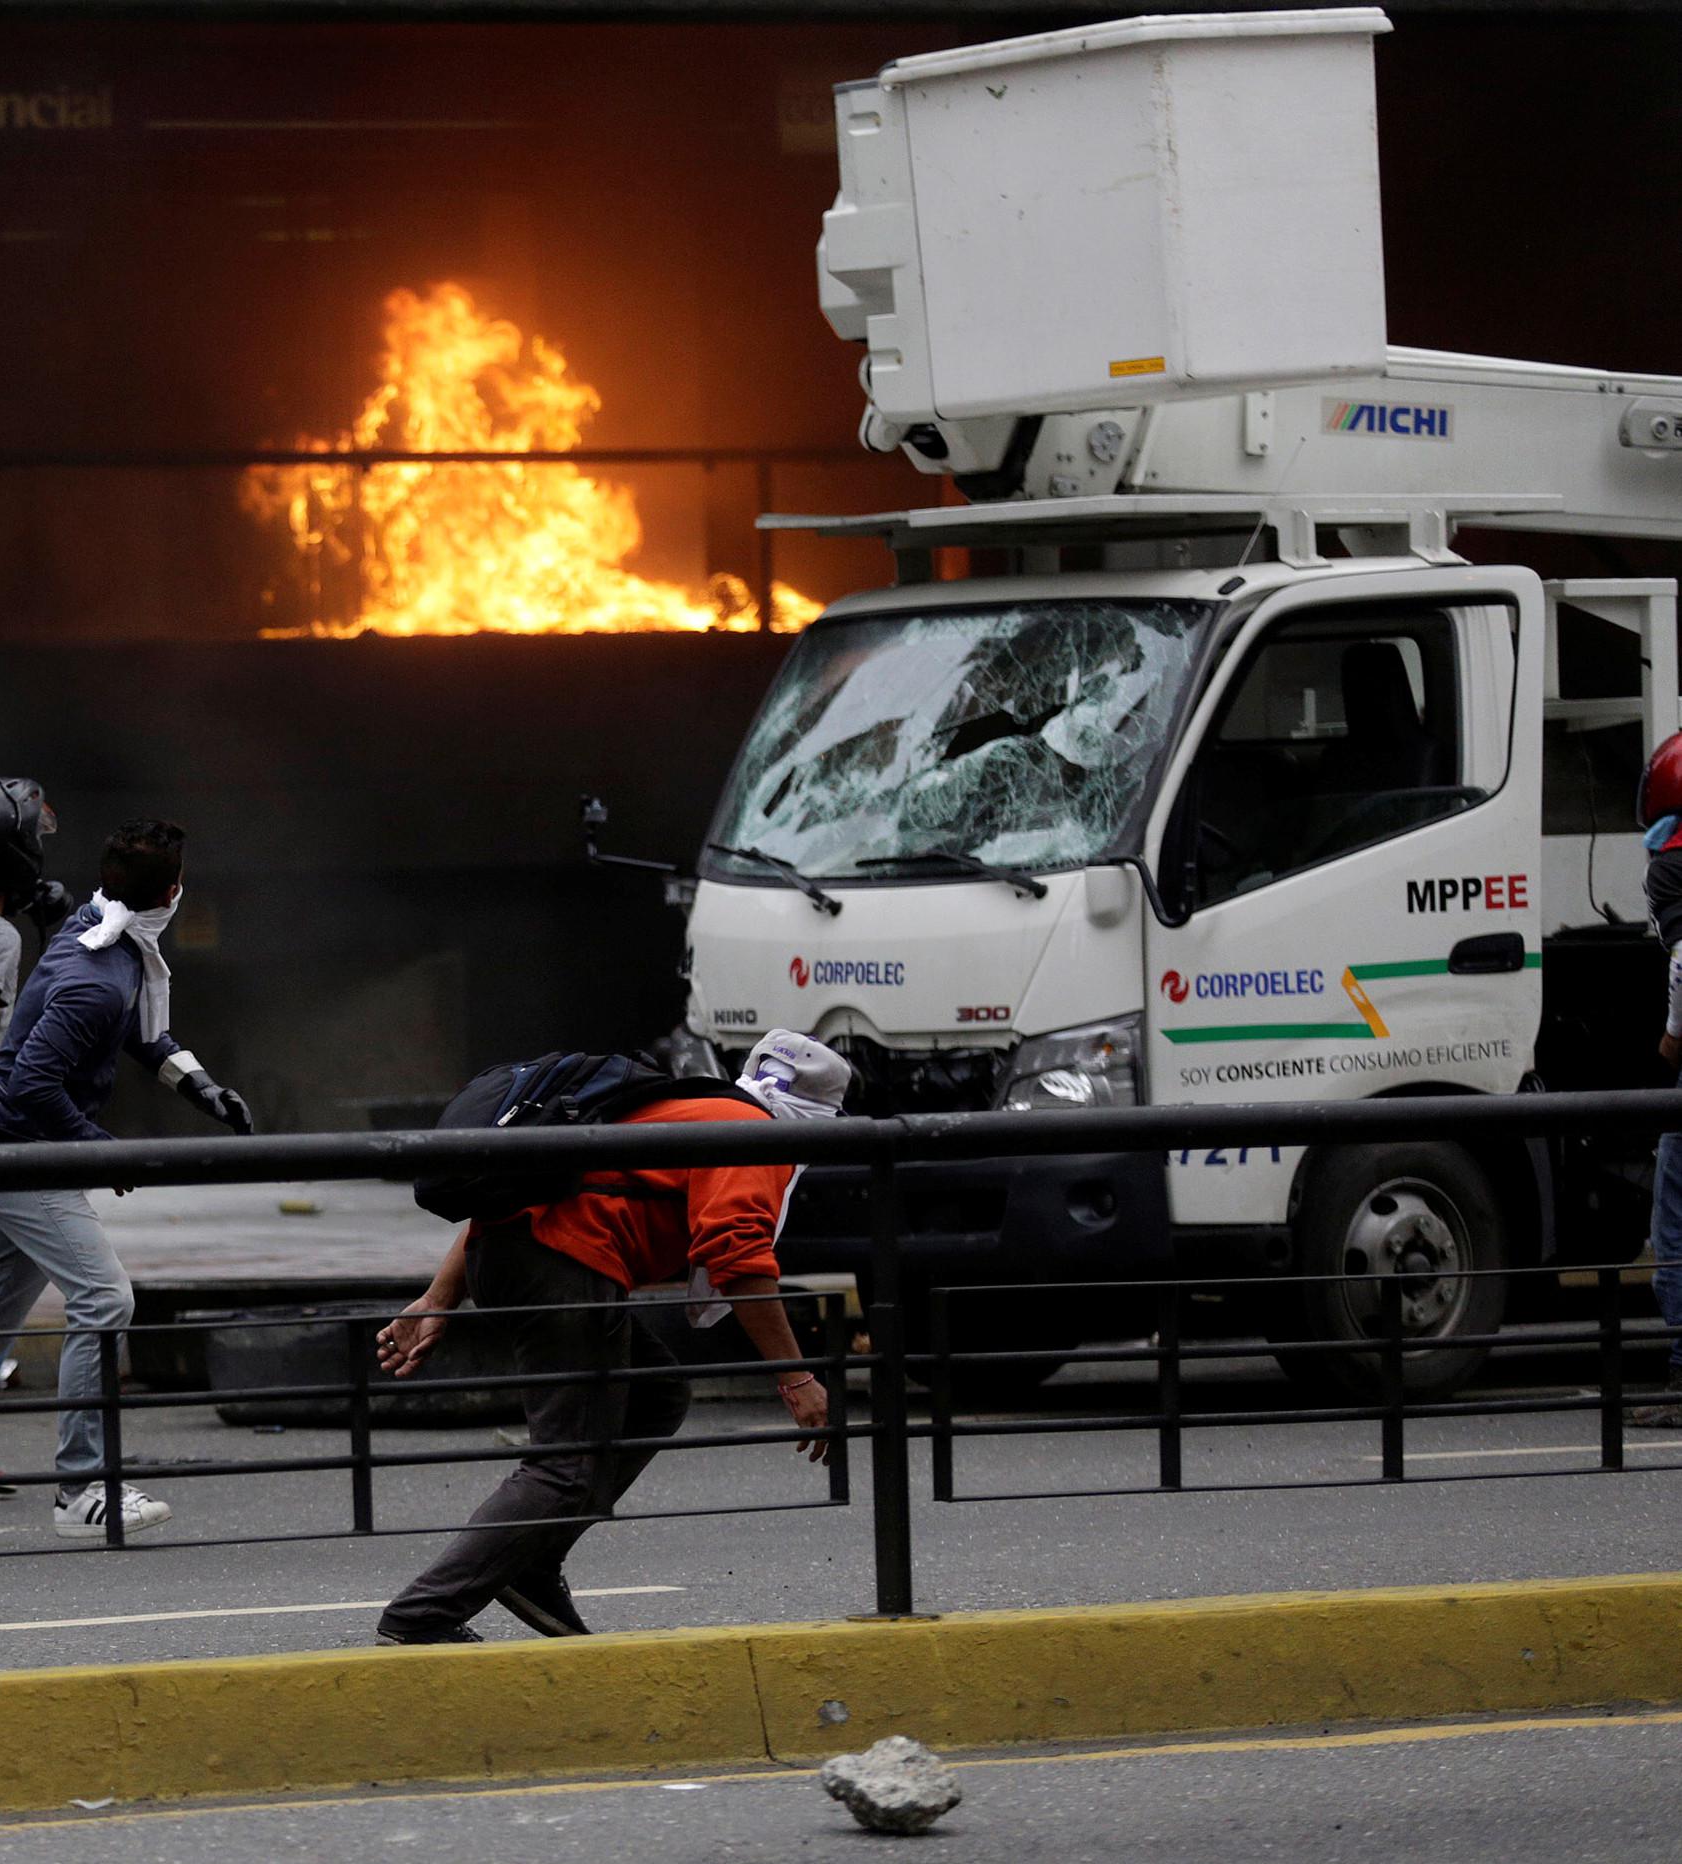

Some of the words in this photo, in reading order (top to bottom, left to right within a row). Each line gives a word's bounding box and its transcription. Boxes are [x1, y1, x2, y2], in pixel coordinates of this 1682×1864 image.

[1347, 403, 1448, 437] AICHI
[1406, 874, 1529, 914] MPPEE
[813, 960, 905, 987] CORPOELEC
[1195, 968, 1325, 999] CORPOELEC
[713, 1007, 758, 1026] HINO
[955, 1005, 1011, 1022] 300
[1179, 1066, 1213, 1087] SOY
[1216, 1056, 1326, 1082] CONSCIENTE
[1329, 1048, 1422, 1074] CONSUMO
[1427, 1039, 1513, 1065] EFICIENTE
